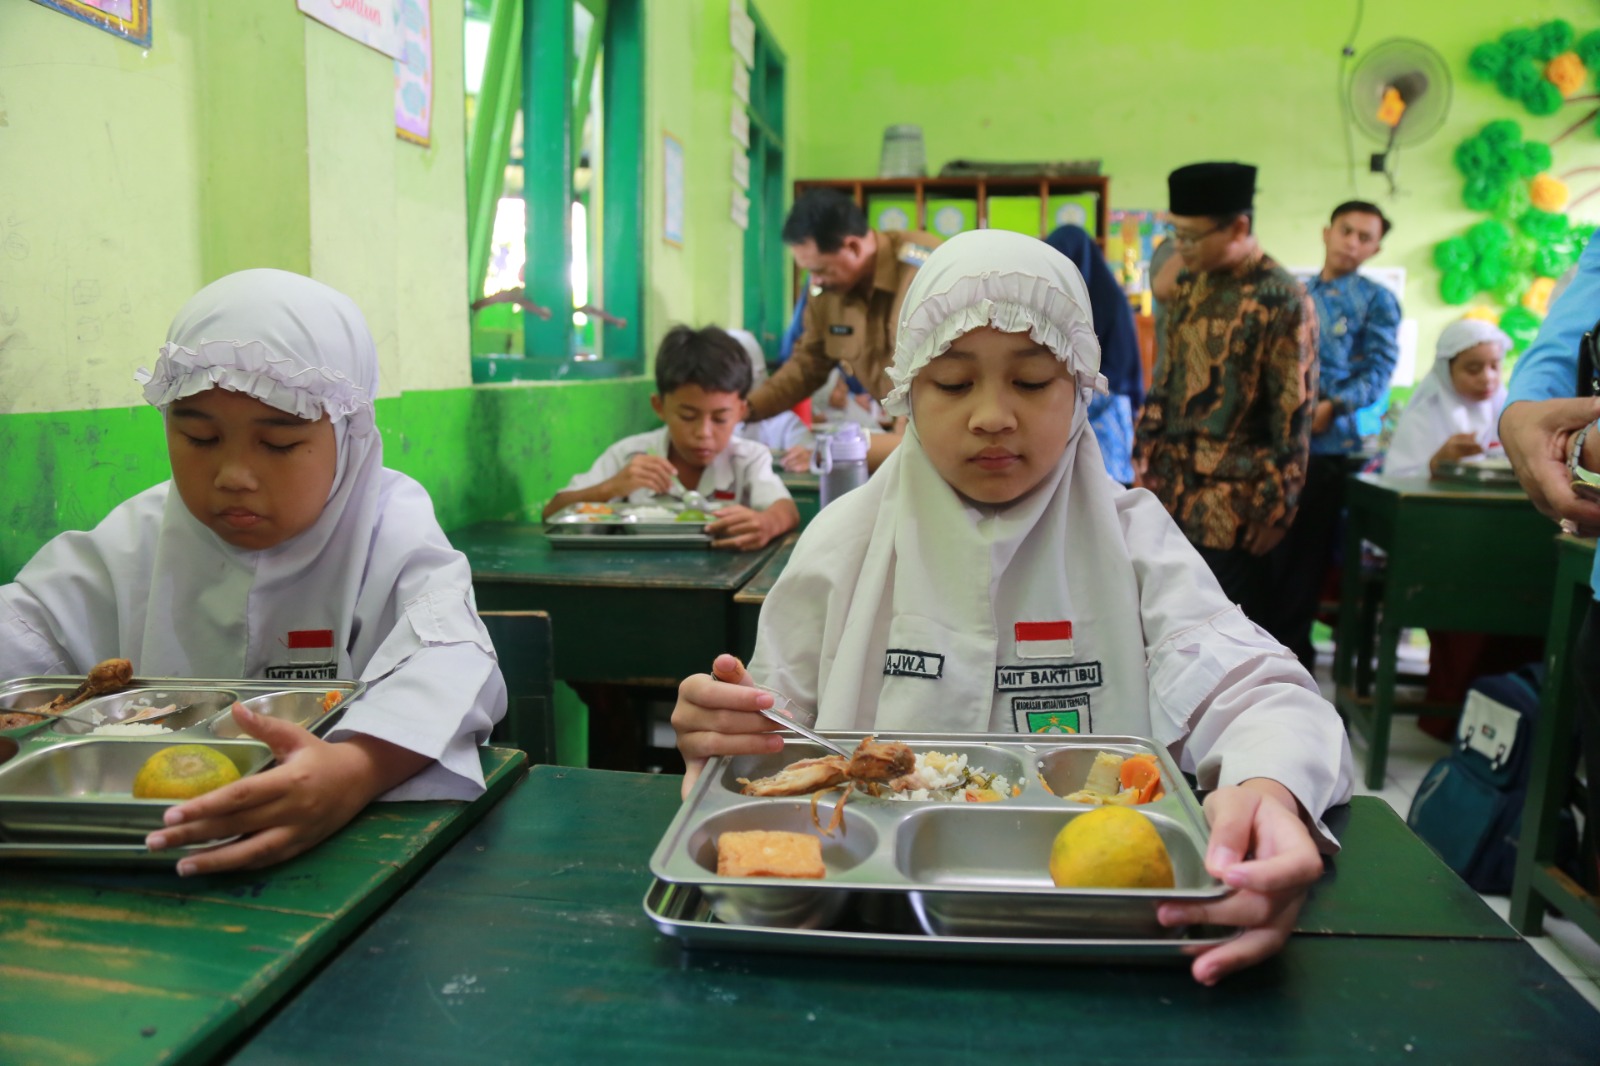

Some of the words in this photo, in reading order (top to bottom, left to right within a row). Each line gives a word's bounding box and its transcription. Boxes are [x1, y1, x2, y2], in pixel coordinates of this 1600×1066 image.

[1000, 671, 1025, 685] MIT
[1031, 669, 1071, 684] BAKTI
[1075, 668, 1096, 682] IBU
